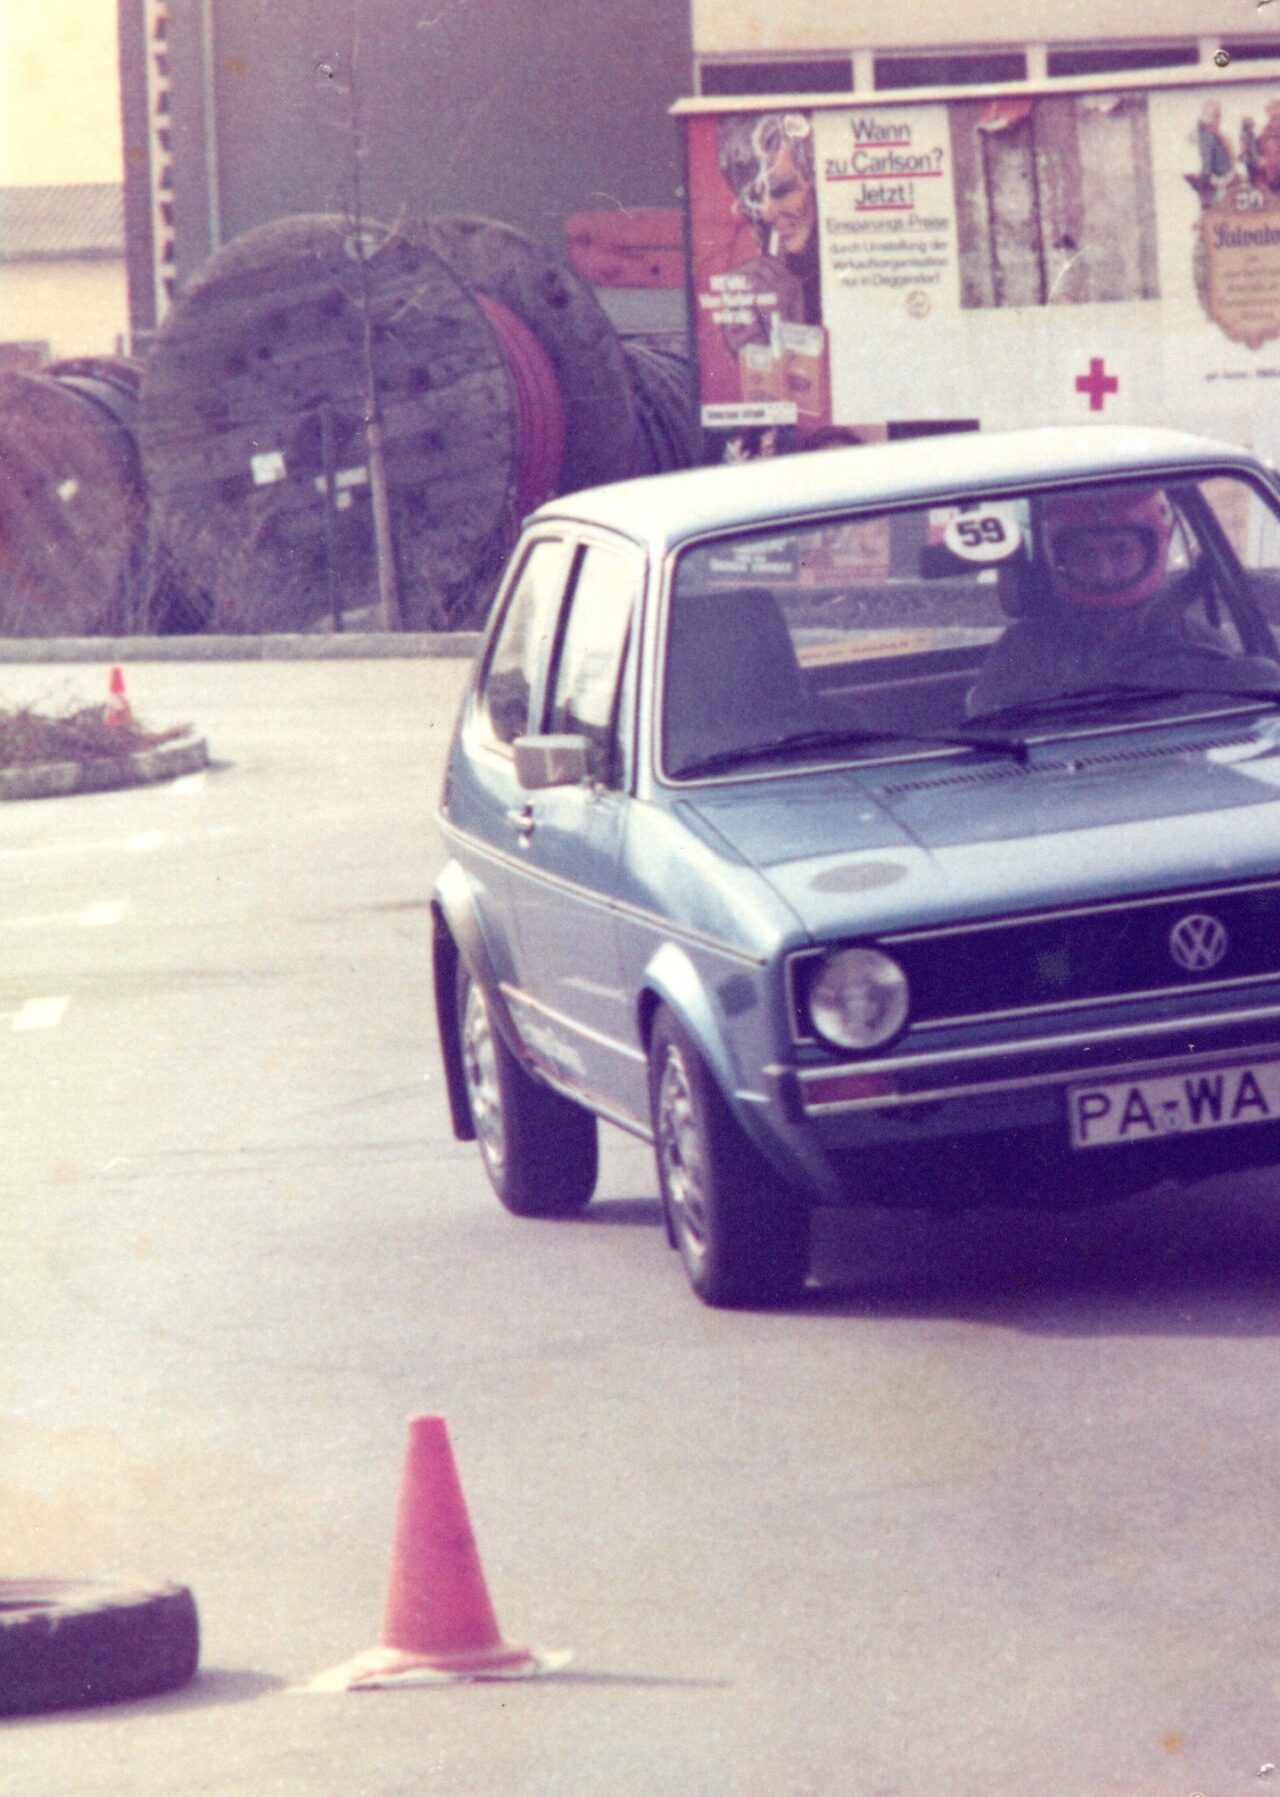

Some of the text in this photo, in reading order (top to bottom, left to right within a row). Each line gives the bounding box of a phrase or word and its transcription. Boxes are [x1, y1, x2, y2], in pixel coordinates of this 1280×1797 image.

[851, 117, 911, 140] Wann
[825, 147, 944, 175] zu Carlson?
[855, 181, 914, 206] Jetzt!
[955, 516, 1007, 548] 59
